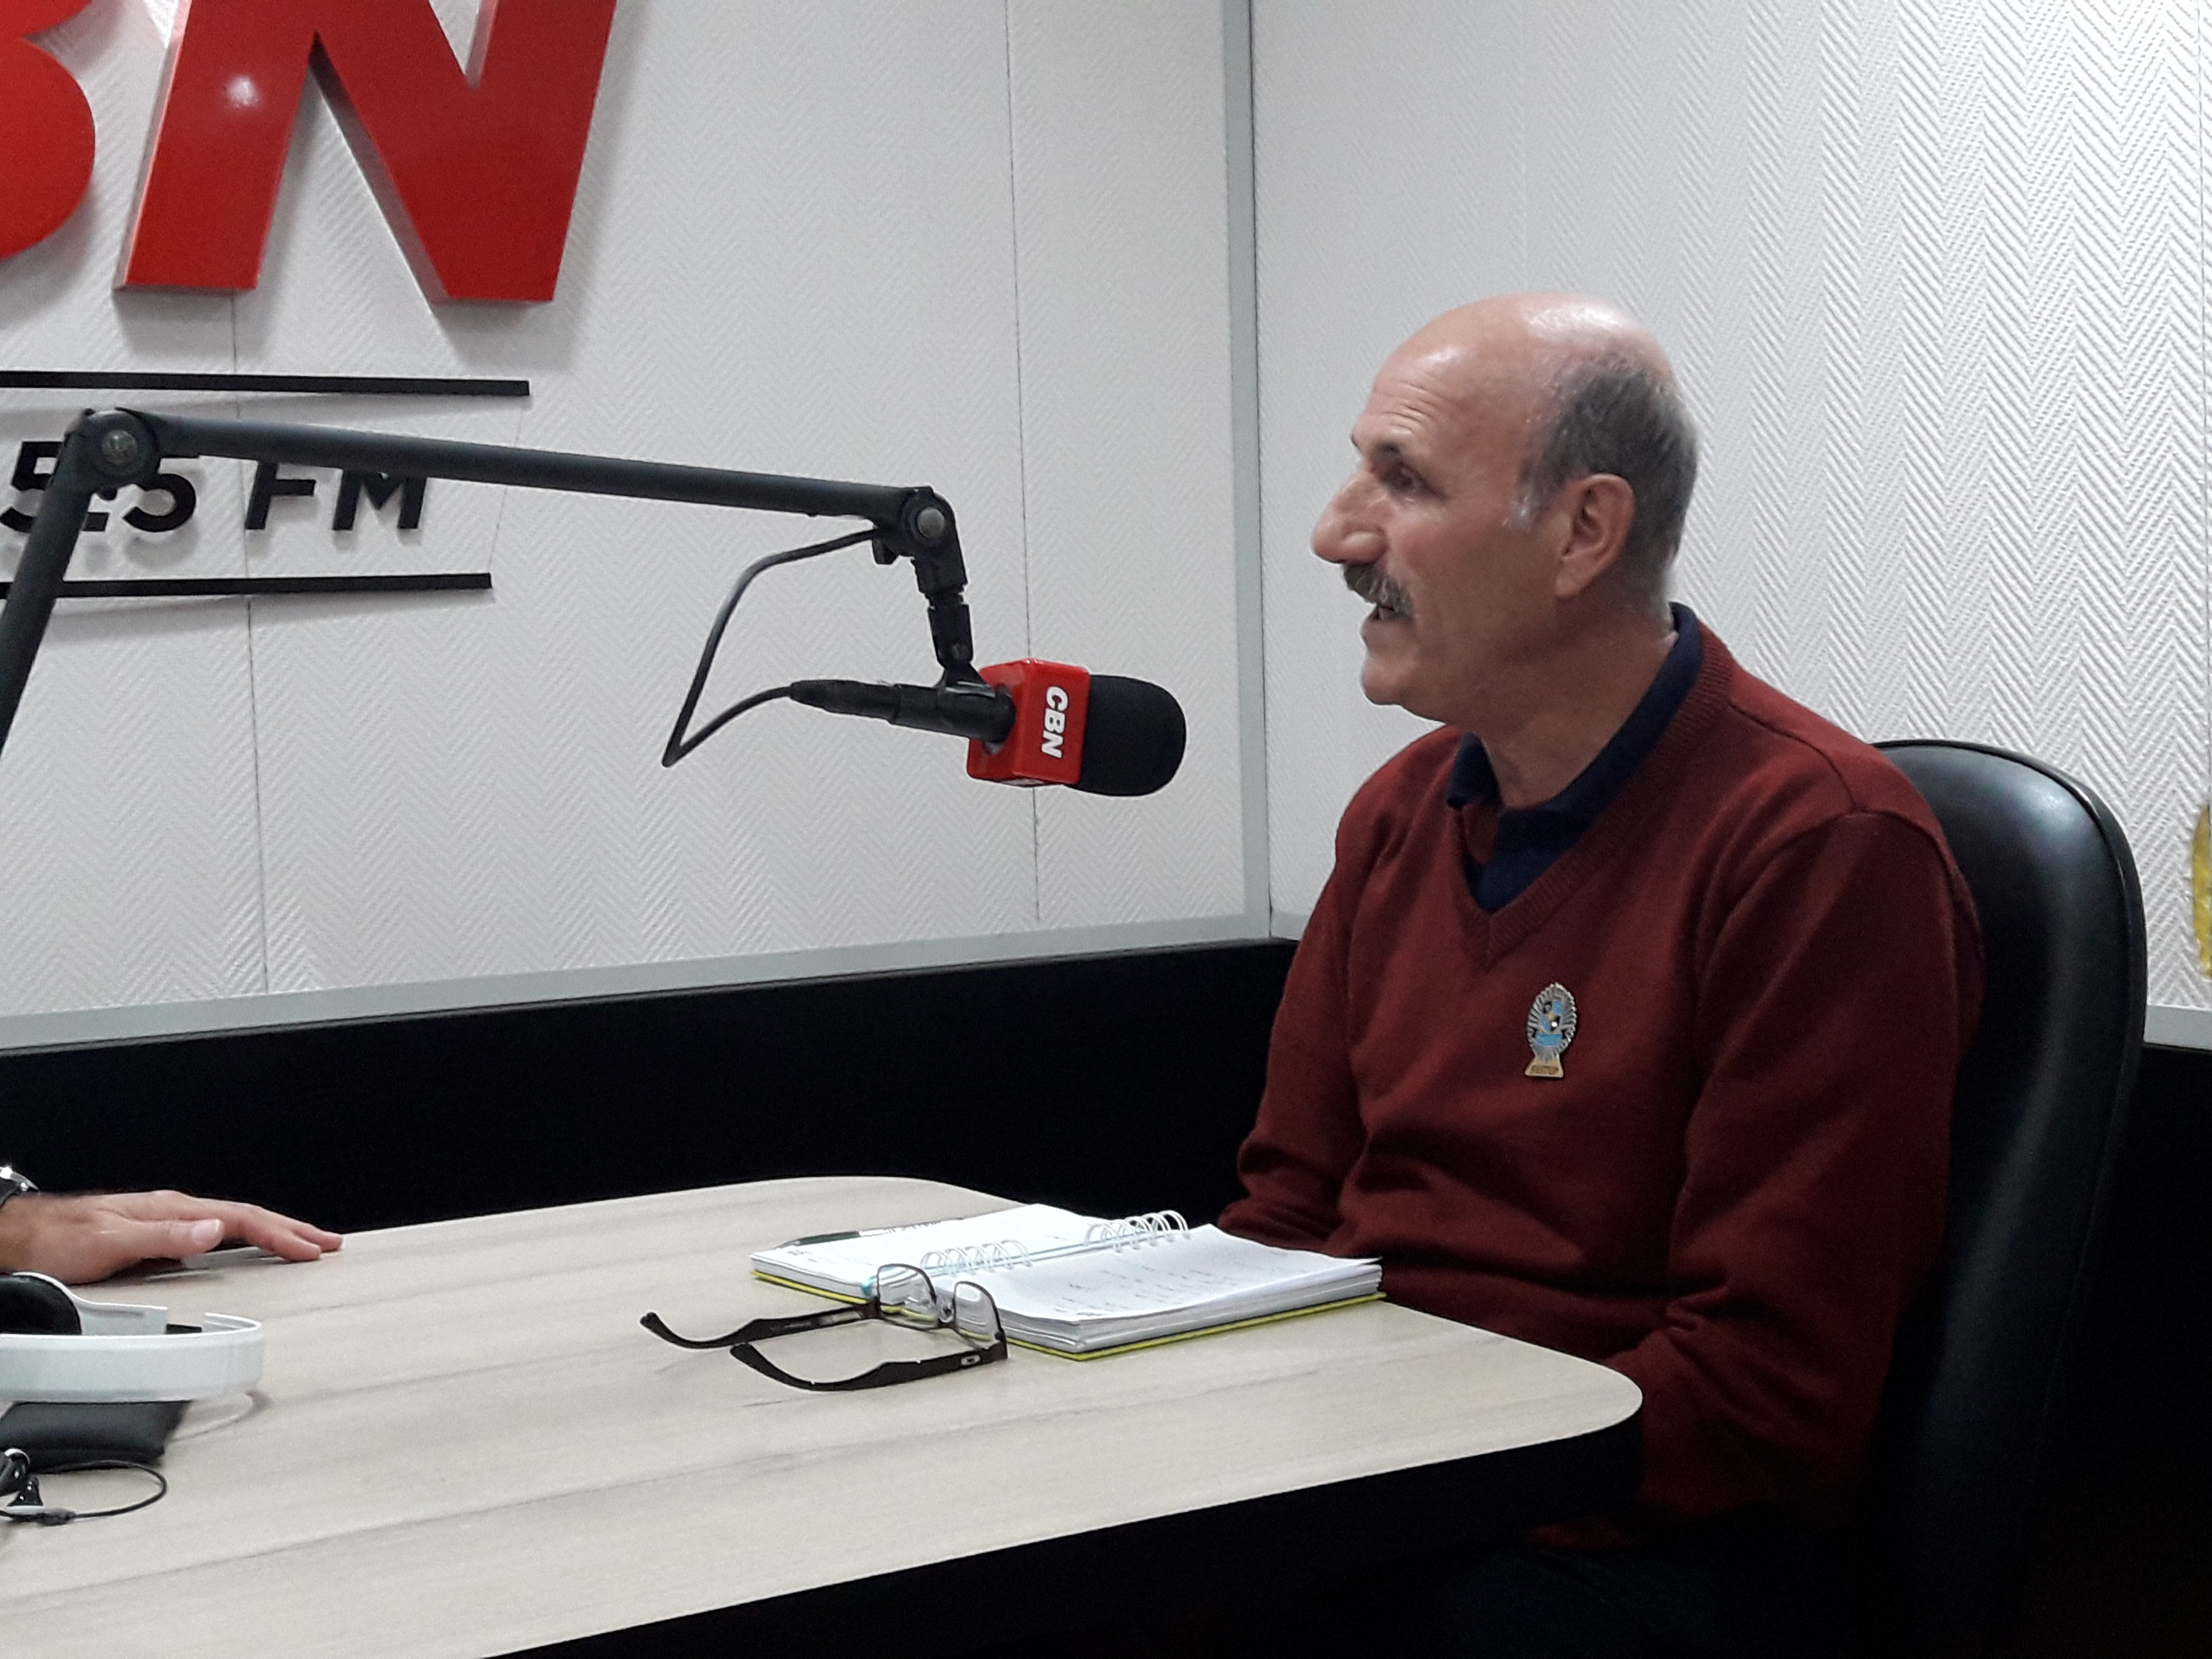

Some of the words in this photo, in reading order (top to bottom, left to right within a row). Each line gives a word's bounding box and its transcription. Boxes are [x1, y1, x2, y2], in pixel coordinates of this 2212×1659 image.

[0, 0, 616, 302] N
[245, 457, 428, 531] FM
[1042, 686, 1068, 758] CBN
